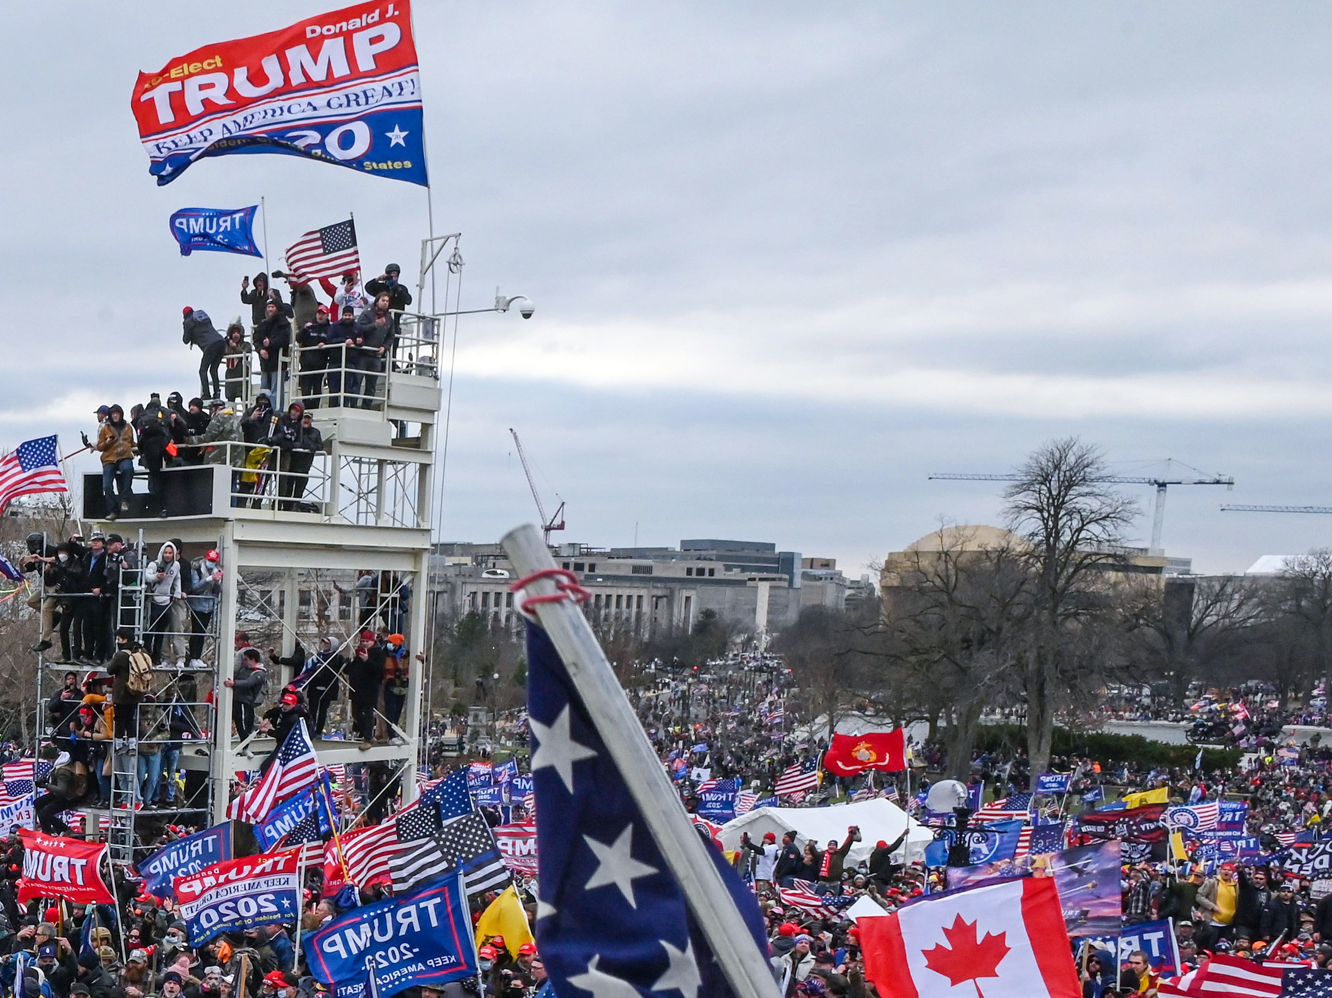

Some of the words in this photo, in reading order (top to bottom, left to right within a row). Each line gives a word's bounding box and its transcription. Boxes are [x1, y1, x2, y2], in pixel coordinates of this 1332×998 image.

[306, 12, 380, 39] Donald
[383, 4, 400, 19] J.
[140, 21, 402, 125] TRUMP
[154, 128, 214, 154] KEEP
[221, 101, 319, 138] AMERICA
[326, 78, 416, 110] GREAT!
[363, 160, 412, 170] States
